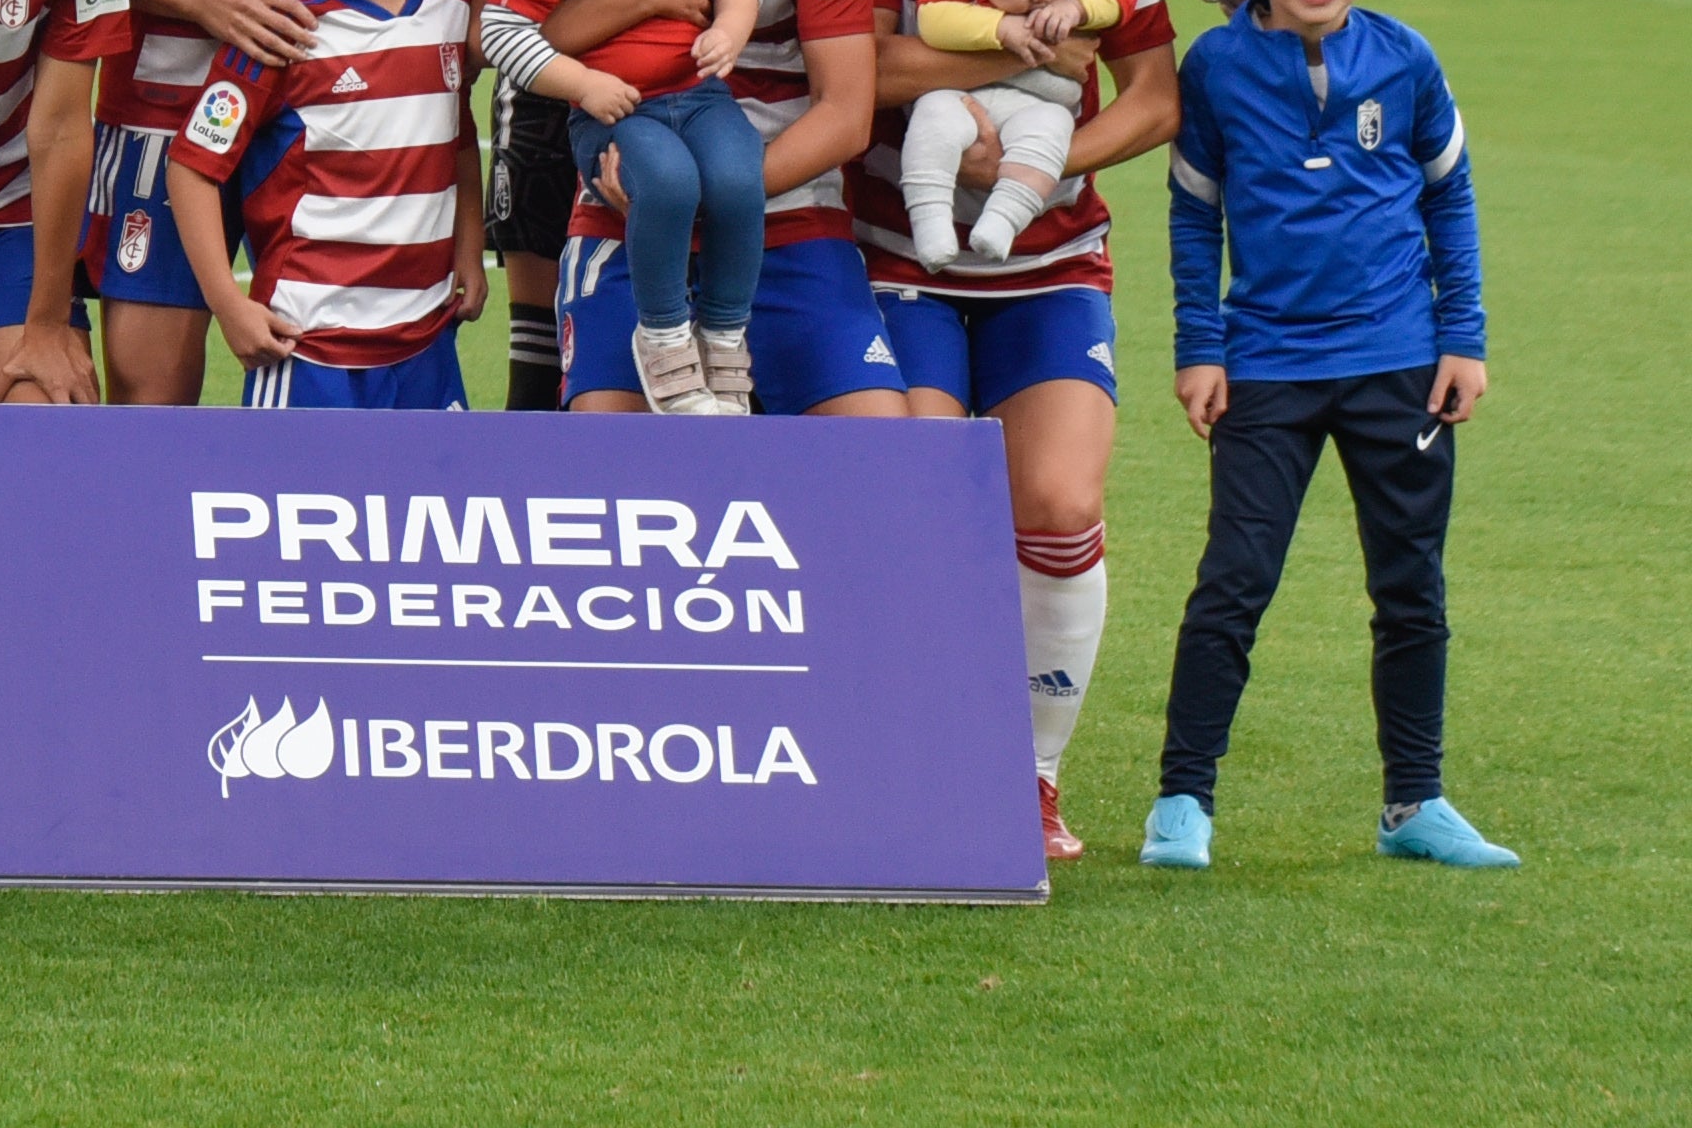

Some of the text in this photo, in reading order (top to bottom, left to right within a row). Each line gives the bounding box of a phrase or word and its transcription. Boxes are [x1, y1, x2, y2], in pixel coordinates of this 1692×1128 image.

[332, 81, 368, 94] adidas
[193, 121, 228, 146] LaLiga
[191, 492, 800, 570] PRIMERA
[197, 573, 805, 633] FEDERACIÓN
[342, 718, 818, 784] IBERDROLA
